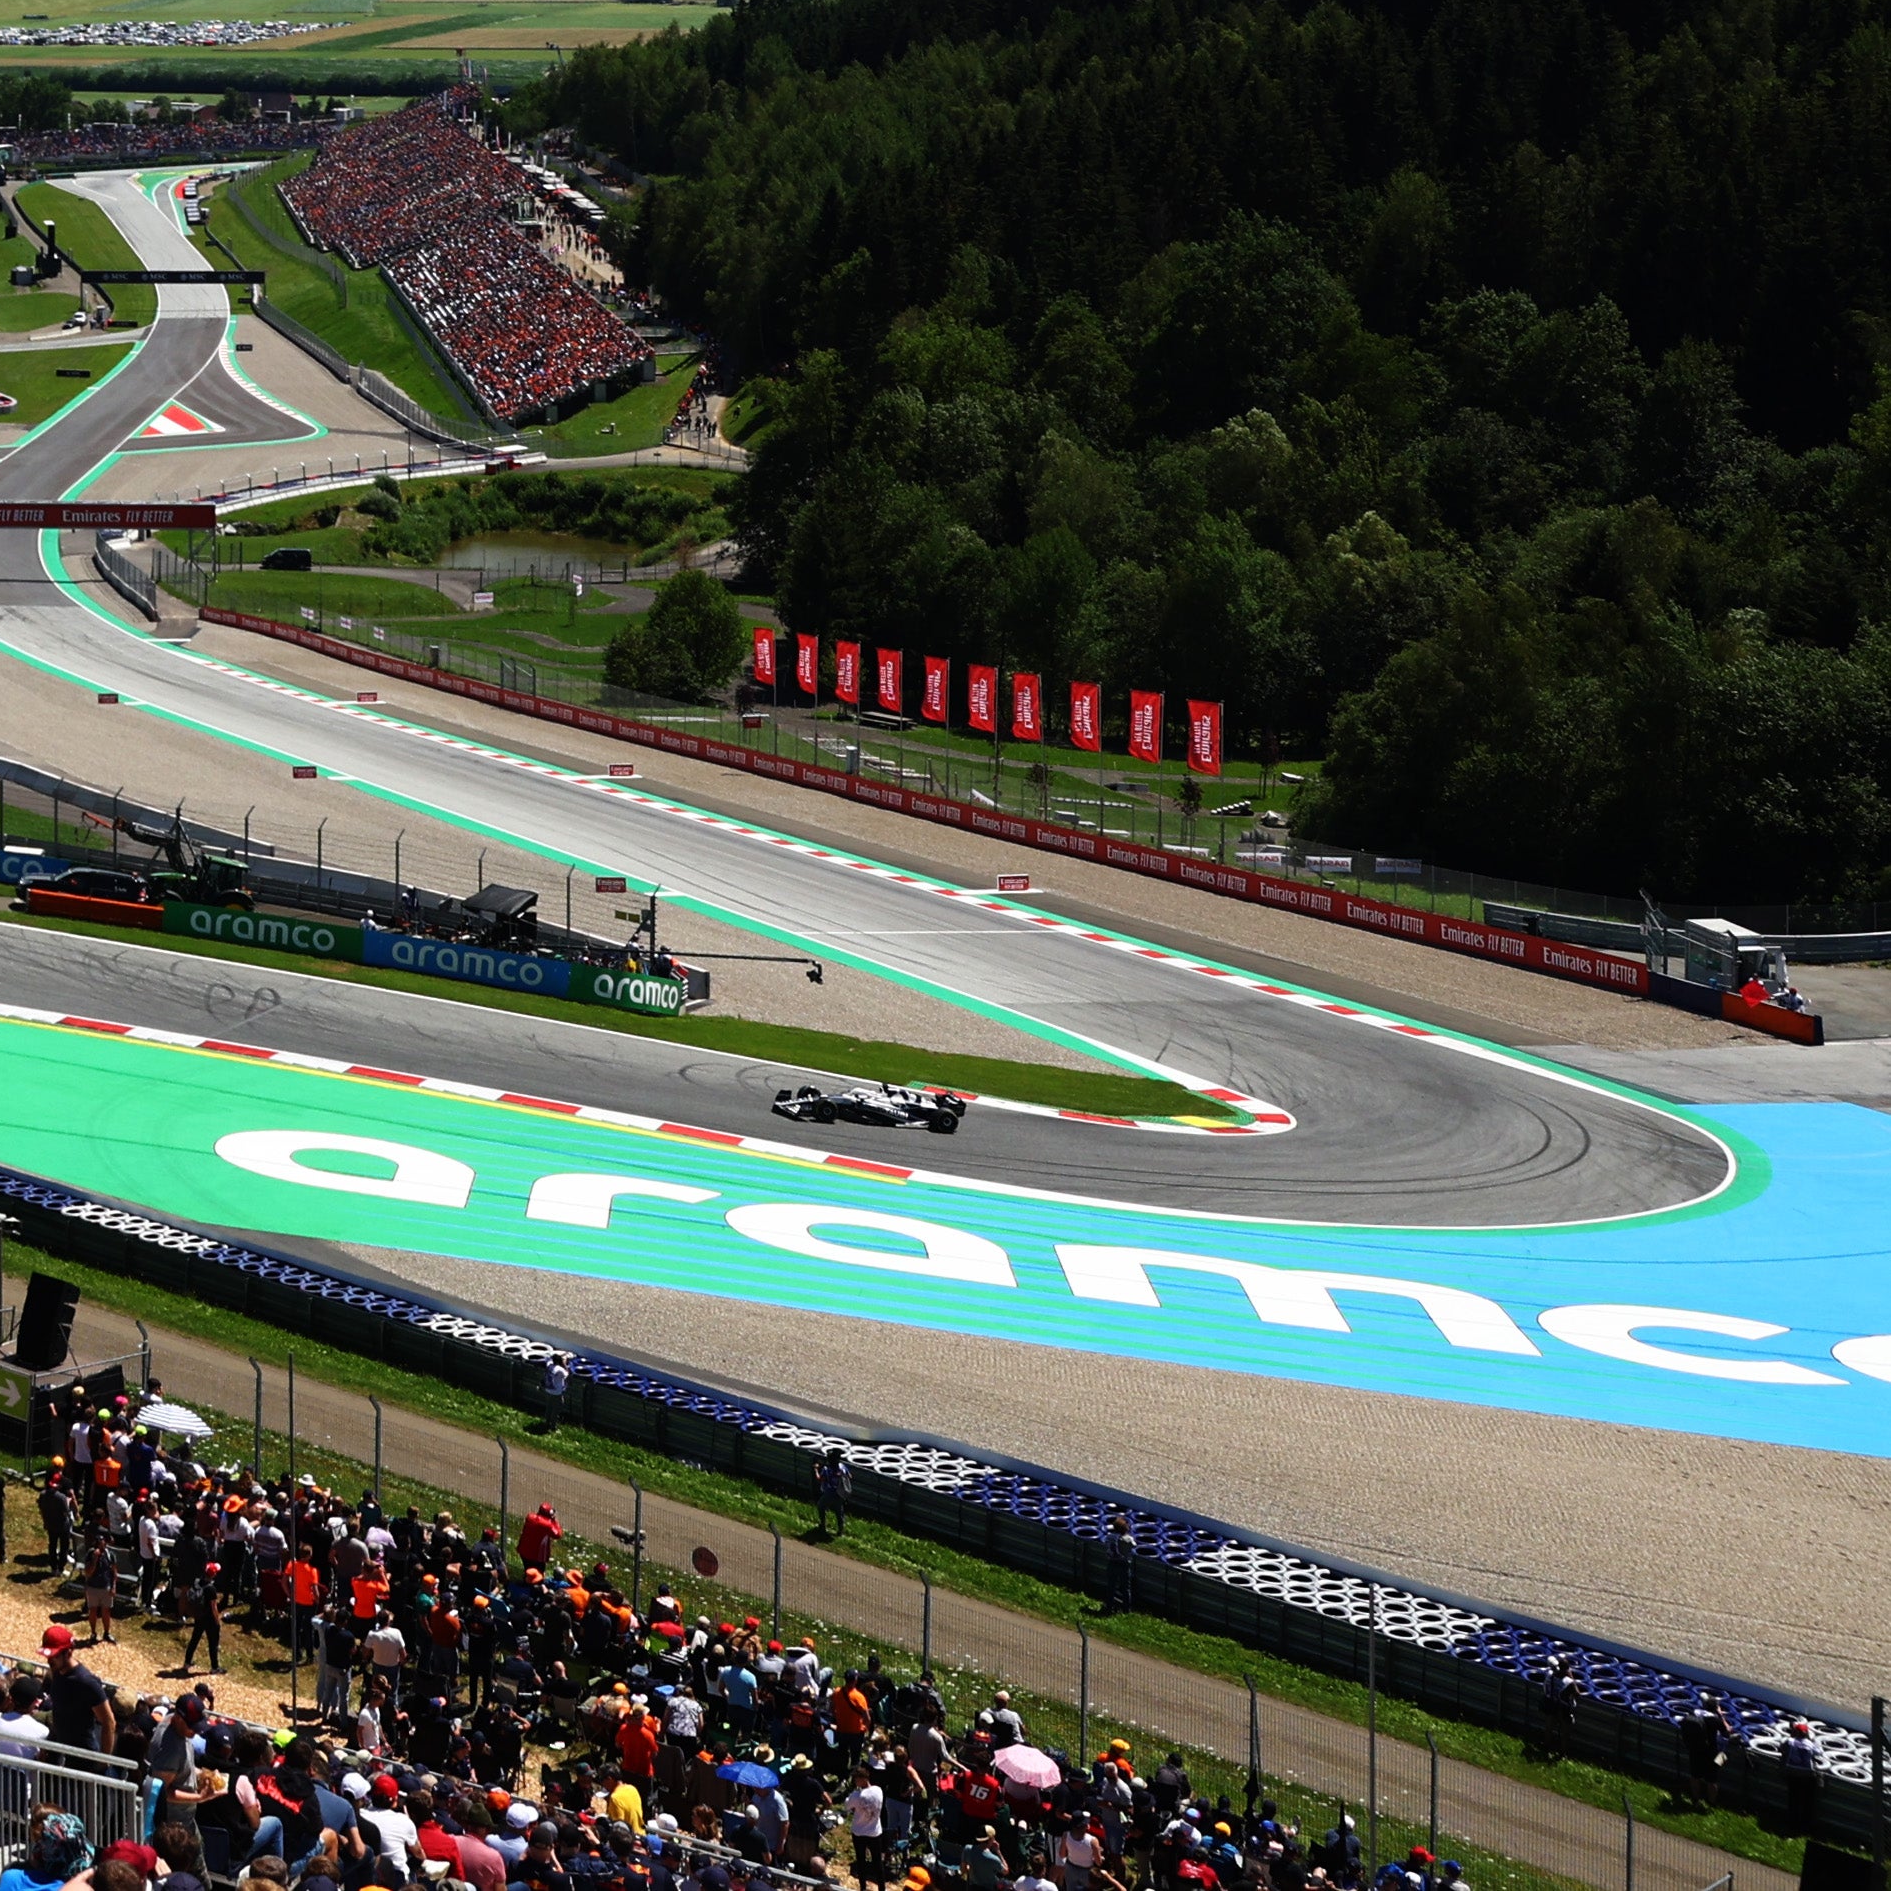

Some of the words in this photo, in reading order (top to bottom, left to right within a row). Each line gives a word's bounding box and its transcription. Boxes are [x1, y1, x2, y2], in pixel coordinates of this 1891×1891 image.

[14, 509, 45, 522] BETTER
[62, 510, 120, 523] Emirates
[126, 511, 140, 523] FLY
[143, 511, 174, 523] BETTER
[1037, 828, 1067, 847] Emirates
[1069, 835, 1078, 850] FLY
[1078, 837, 1095, 854] BETTER
[1107, 845, 1138, 866] Emirates
[1140, 855, 1150, 869] FLY
[1150, 856, 1168, 872] BETTER
[1180, 863, 1216, 885] Emirates
[1217, 870, 1227, 887] FLY
[1228, 873, 1246, 892] BETTER
[1260, 882, 1297, 905] Emirates
[1300, 891, 1310, 907] FLY
[1310, 893, 1331, 911] BETTER
[190, 910, 335, 952] aramco
[1347, 901, 1388, 926] Emirates
[1390, 912, 1401, 929] FLY
[1401, 914, 1424, 935] BETTER
[1440, 923, 1485, 947] Emirates
[1488, 935, 1499, 952] FLY
[1500, 938, 1525, 957] BETTER
[392, 941, 543, 986] aramco
[1543, 946, 1592, 975] Emirates
[1596, 959, 1609, 981] FLY
[1610, 963, 1637, 985] BETTER
[594, 974, 678, 1009] aramco
[214, 1129, 1891, 1387] aramc
[969, 1783, 990, 1800] 16
